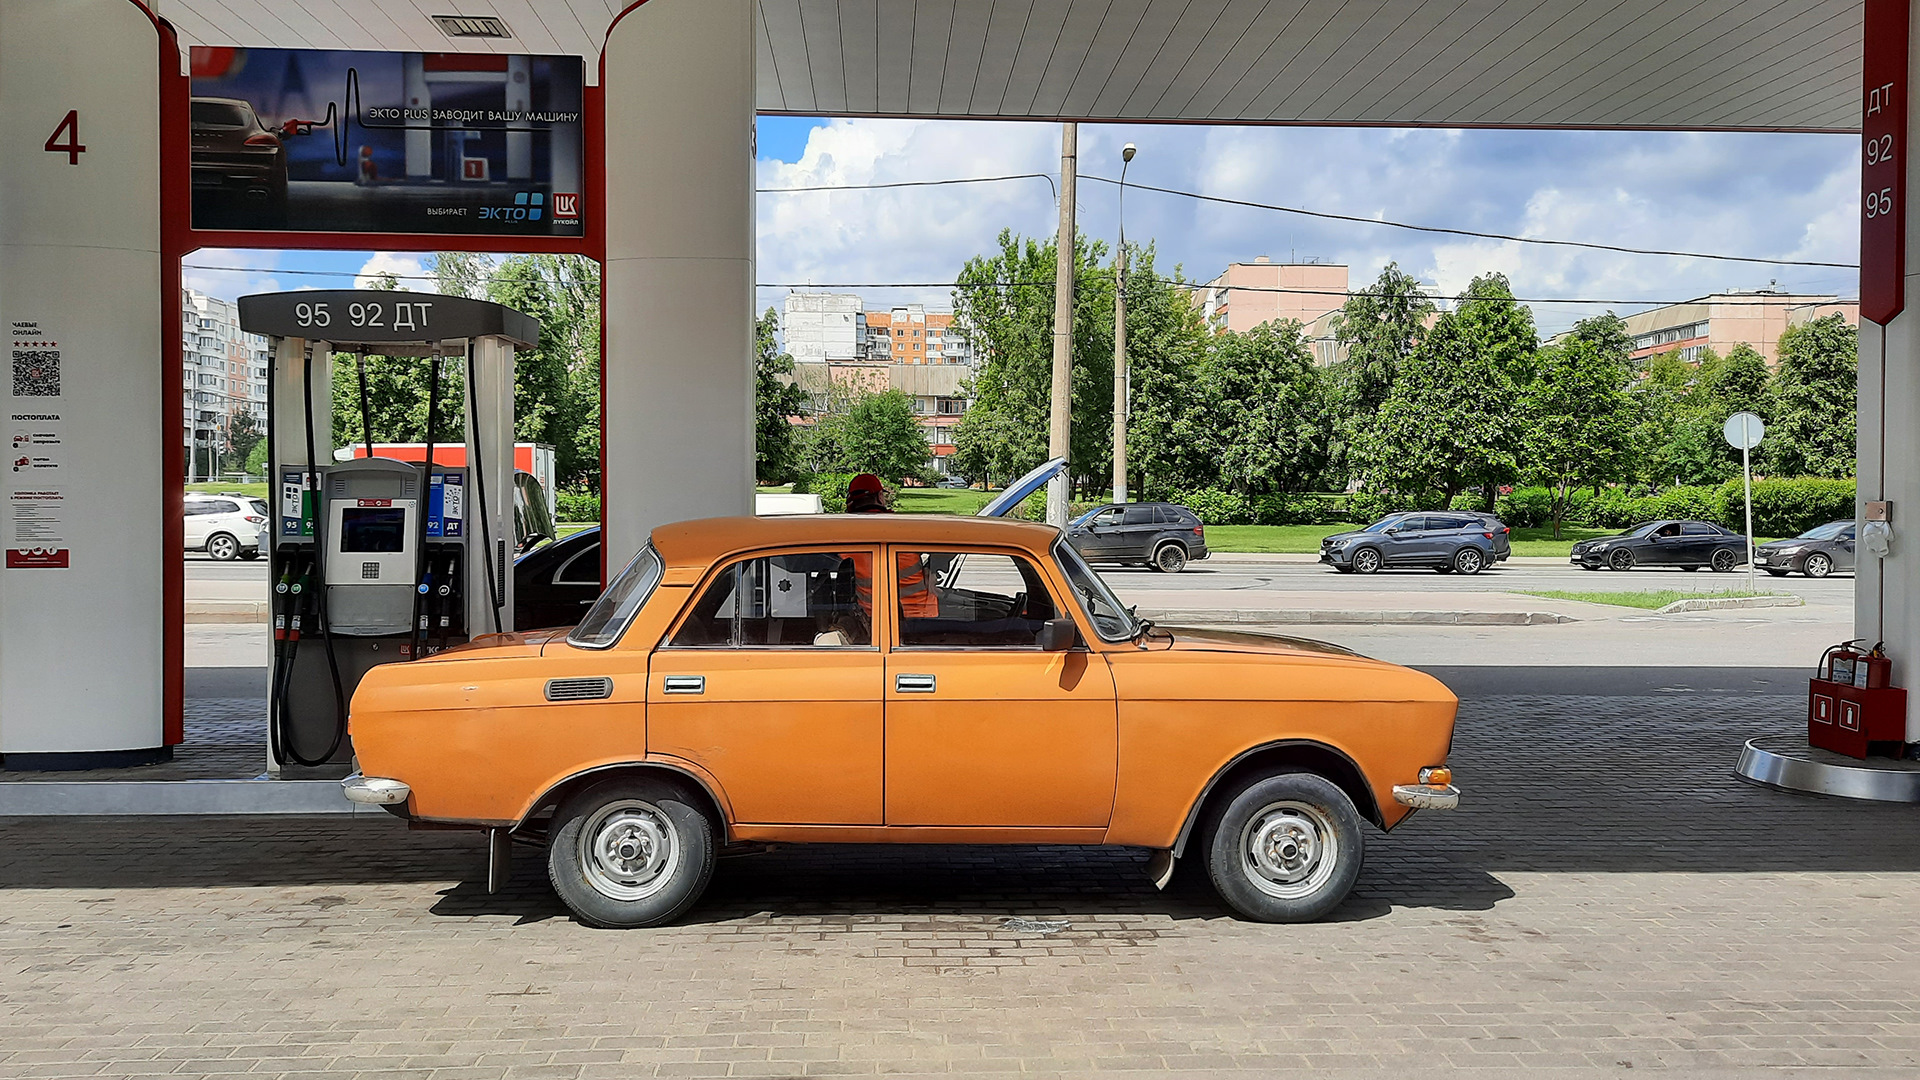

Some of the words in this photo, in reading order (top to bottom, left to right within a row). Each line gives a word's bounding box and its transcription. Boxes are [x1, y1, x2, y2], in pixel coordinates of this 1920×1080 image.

[1867, 82, 1894, 117] ДТ
[369, 108, 400, 119] ЭКТО
[404, 108, 429, 120] PLUS
[432, 110, 484, 122] ЗАВОДИТ
[488, 110, 521, 121] ВАШУ
[525, 111, 579, 123] МАШИНУ
[45, 110, 86, 165] 4
[1866, 133, 1893, 166] 92
[1866, 187, 1892, 219] 95
[426, 207, 468, 216] ВЫБИРАЕТ
[478, 207, 526, 220] ЭКТО
[295, 302, 331, 327] 95
[348, 302, 384, 327] 92
[393, 302, 432, 332] ДТ
[286, 521, 297, 529] 95
[427, 521, 439, 529] 92
[446, 522, 459, 530] ДТ
